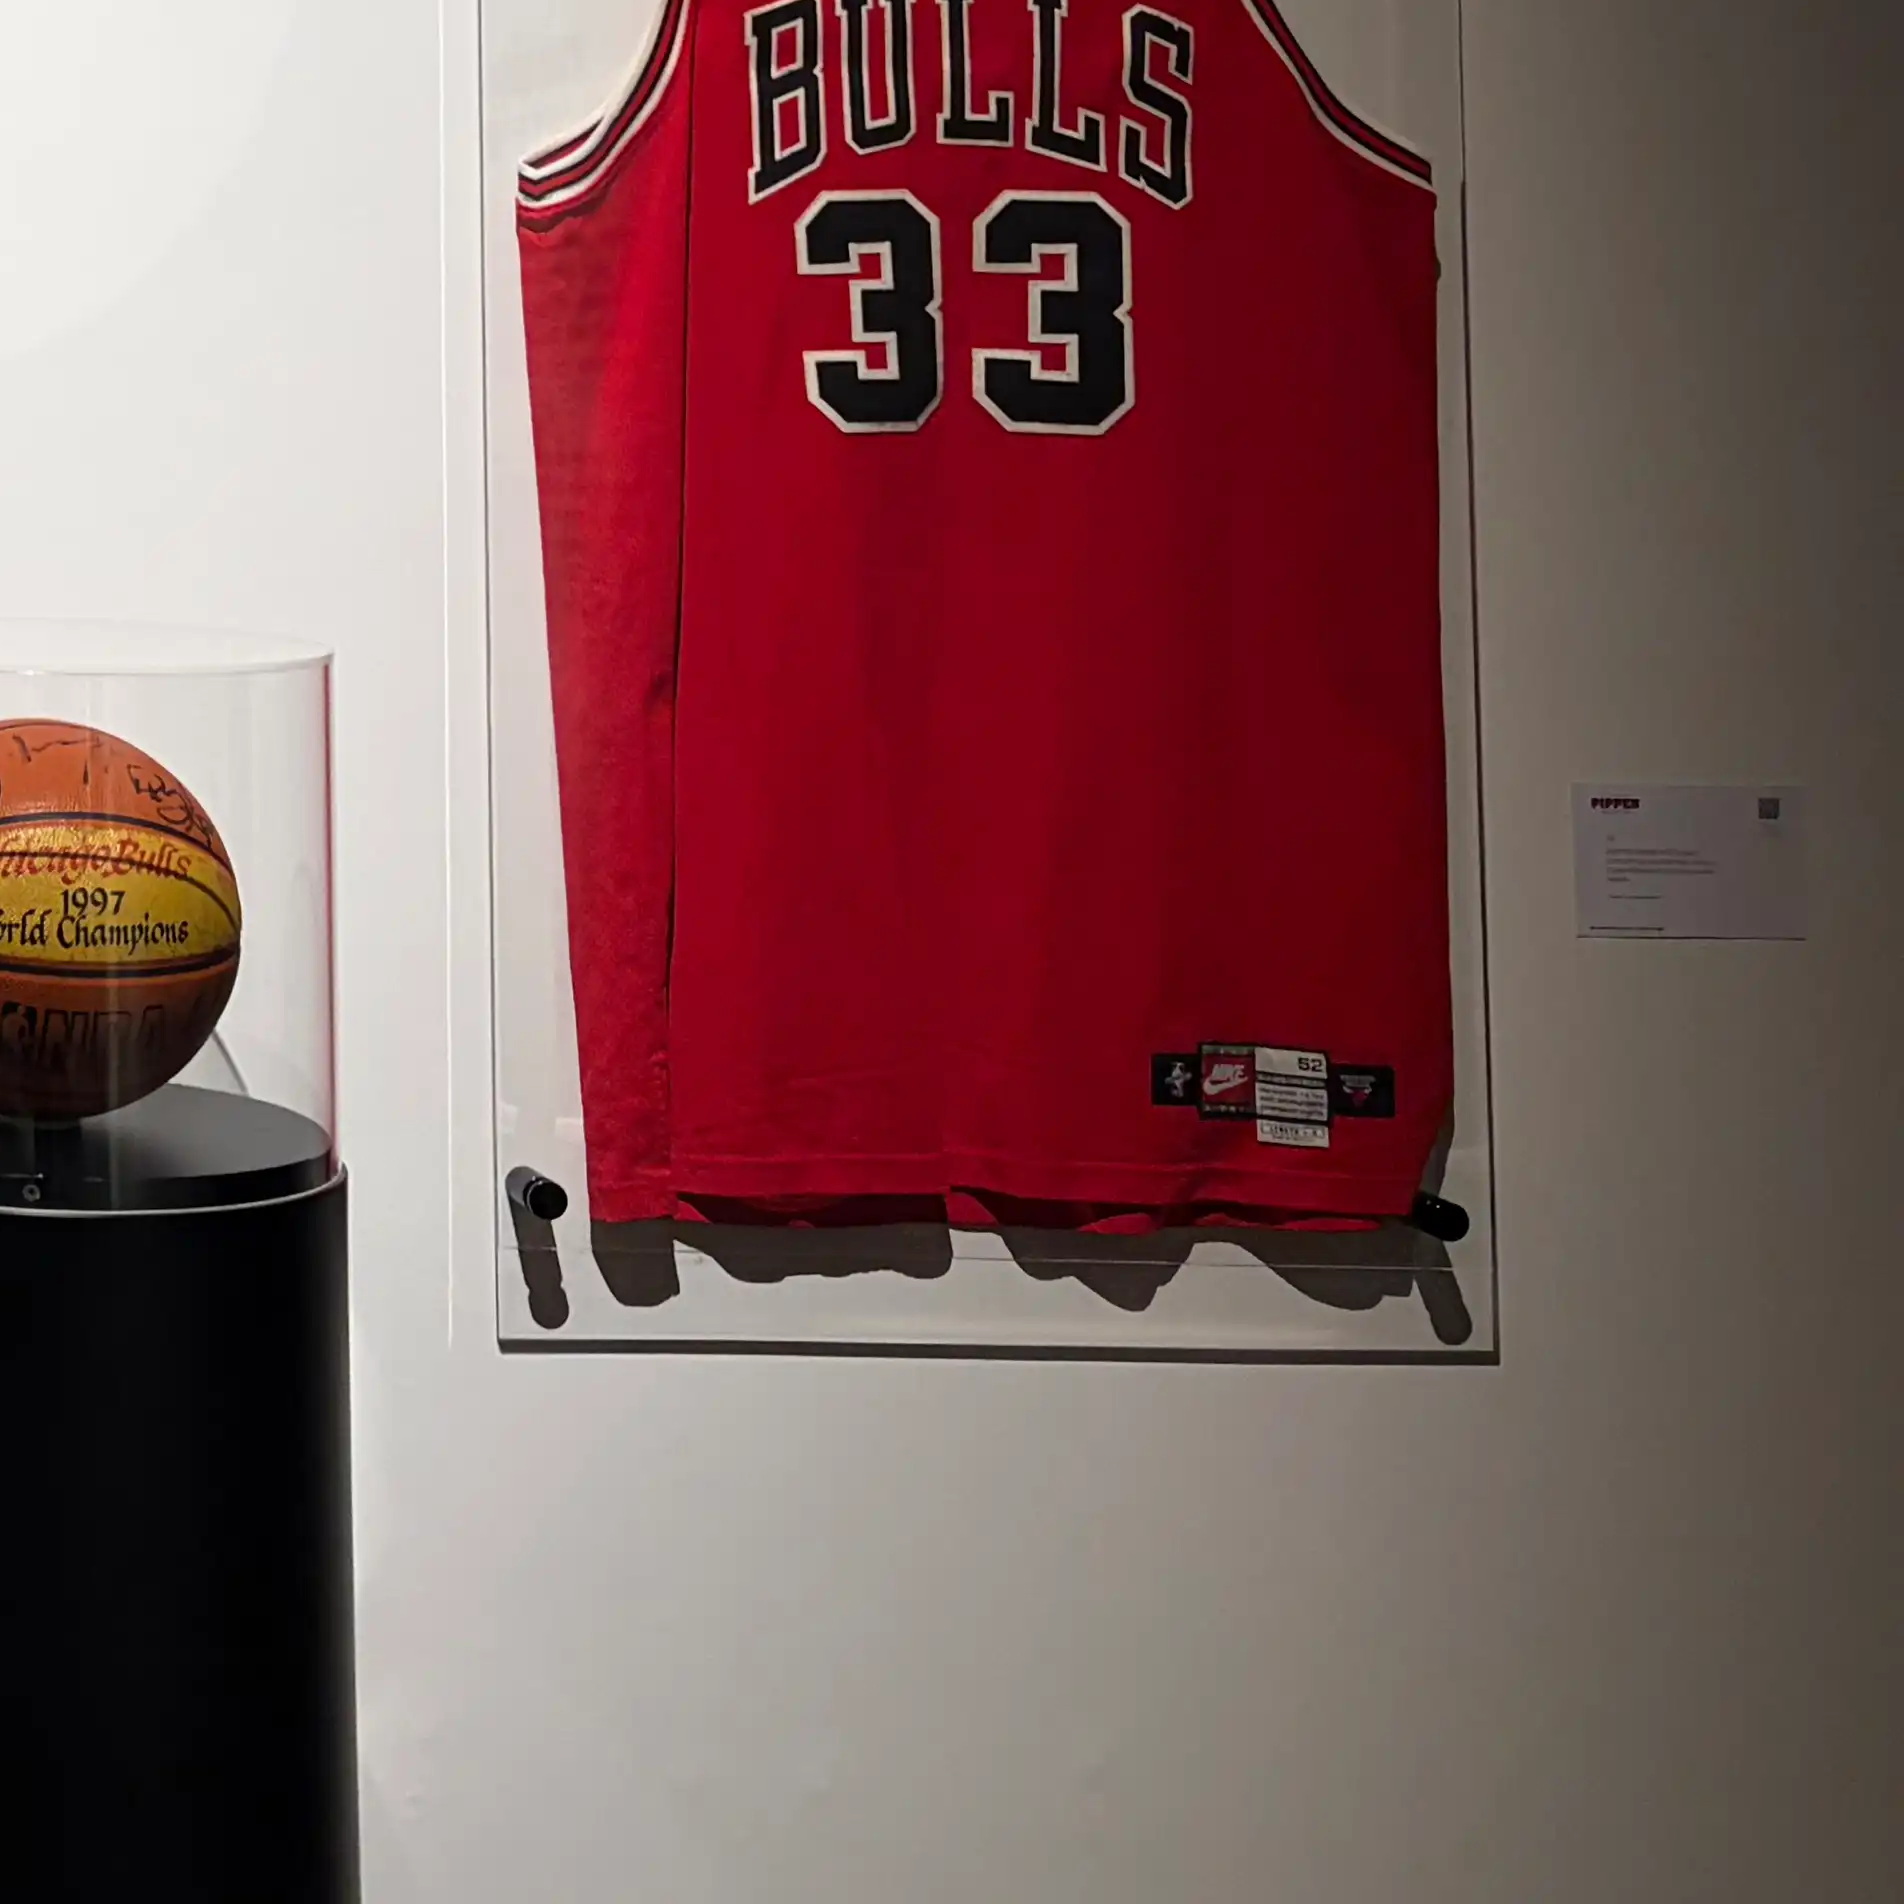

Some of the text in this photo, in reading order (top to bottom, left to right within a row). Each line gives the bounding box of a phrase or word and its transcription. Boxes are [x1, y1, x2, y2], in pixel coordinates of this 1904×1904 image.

[794, 189, 1135, 435] 33
[115, 839, 192, 879] Bulls
[60, 887, 125, 916] 1997
[57, 912, 189, 956] Champions
[1211, 1064, 1246, 1082] NIKE
[1298, 1057, 1323, 1072] 52
